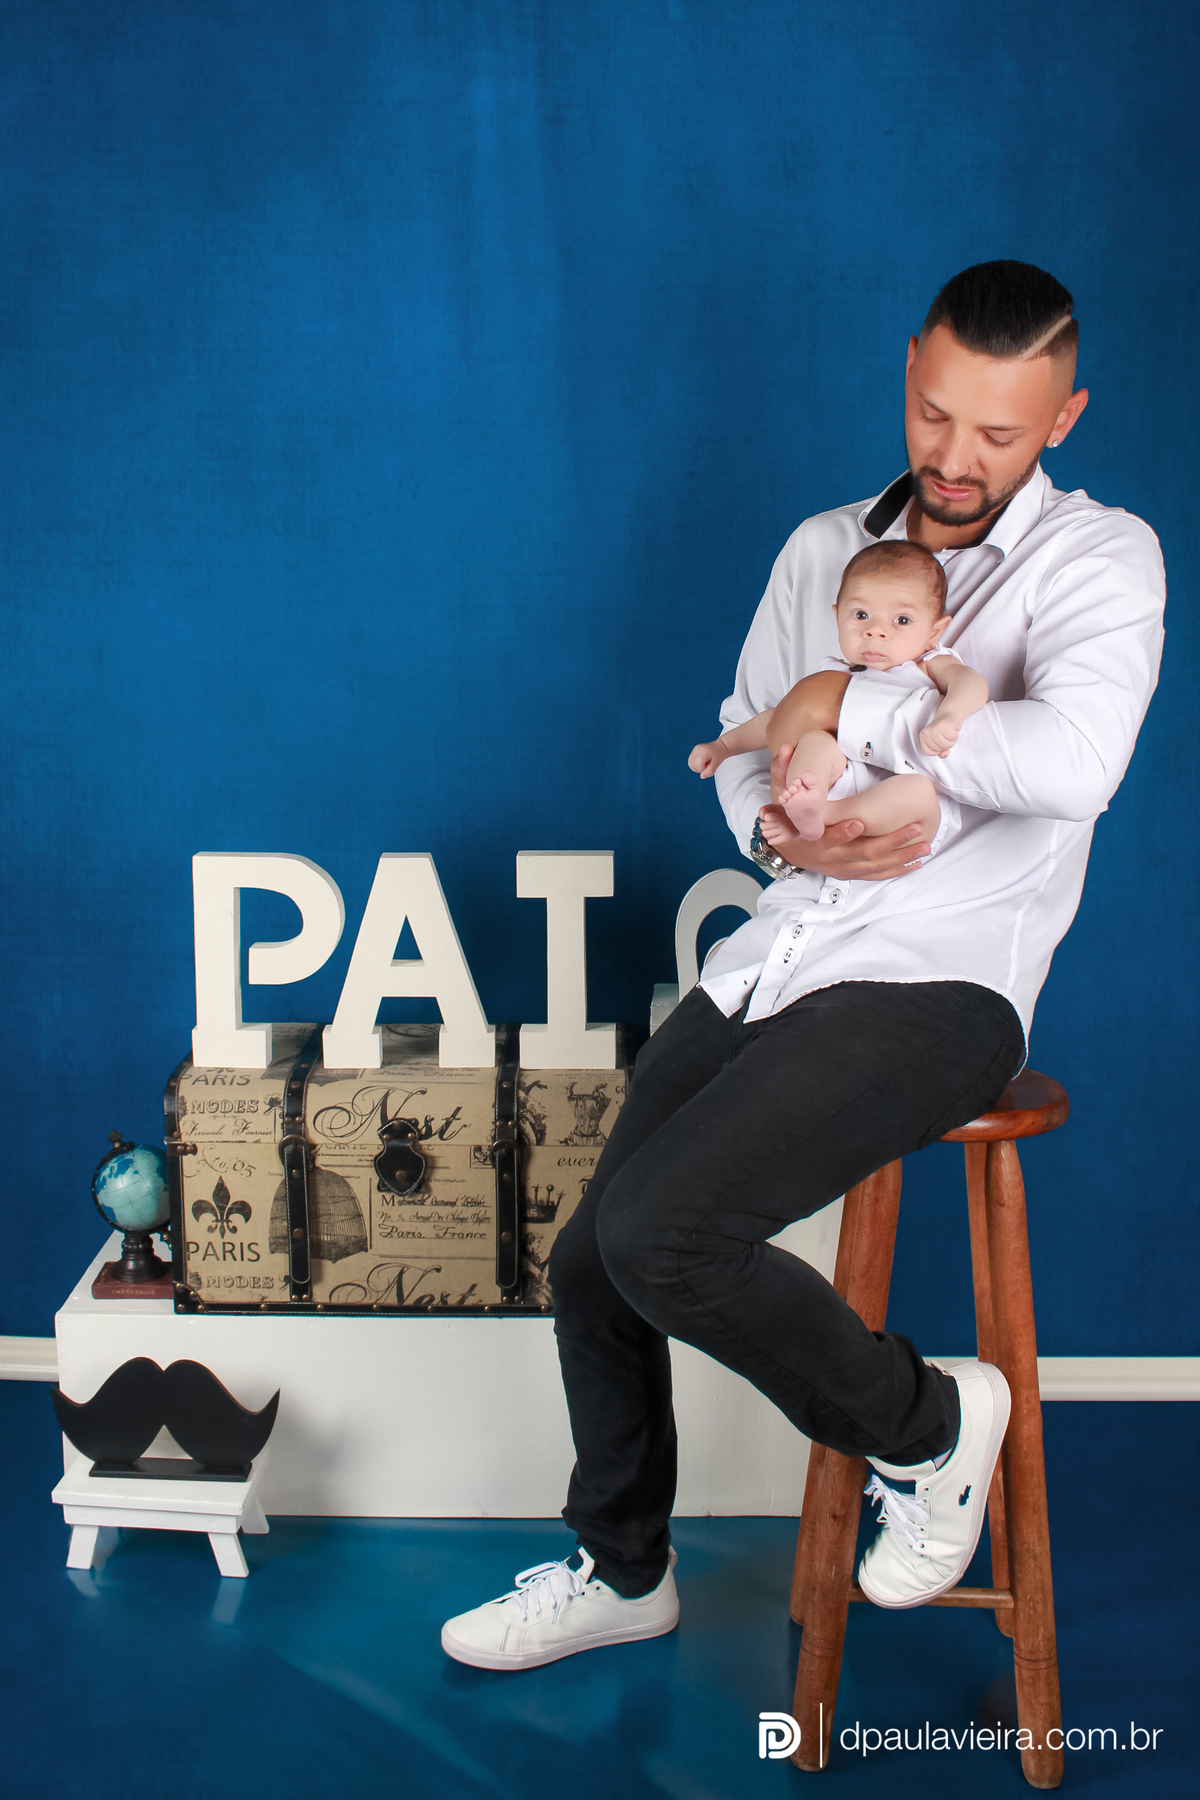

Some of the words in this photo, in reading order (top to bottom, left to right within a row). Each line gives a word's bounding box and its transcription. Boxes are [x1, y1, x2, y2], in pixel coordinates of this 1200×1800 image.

[190, 1099, 259, 1114] MODES
[432, 1224, 487, 1239] France
[186, 1241, 261, 1262] PARIS
[206, 1275, 275, 1289] MODES
